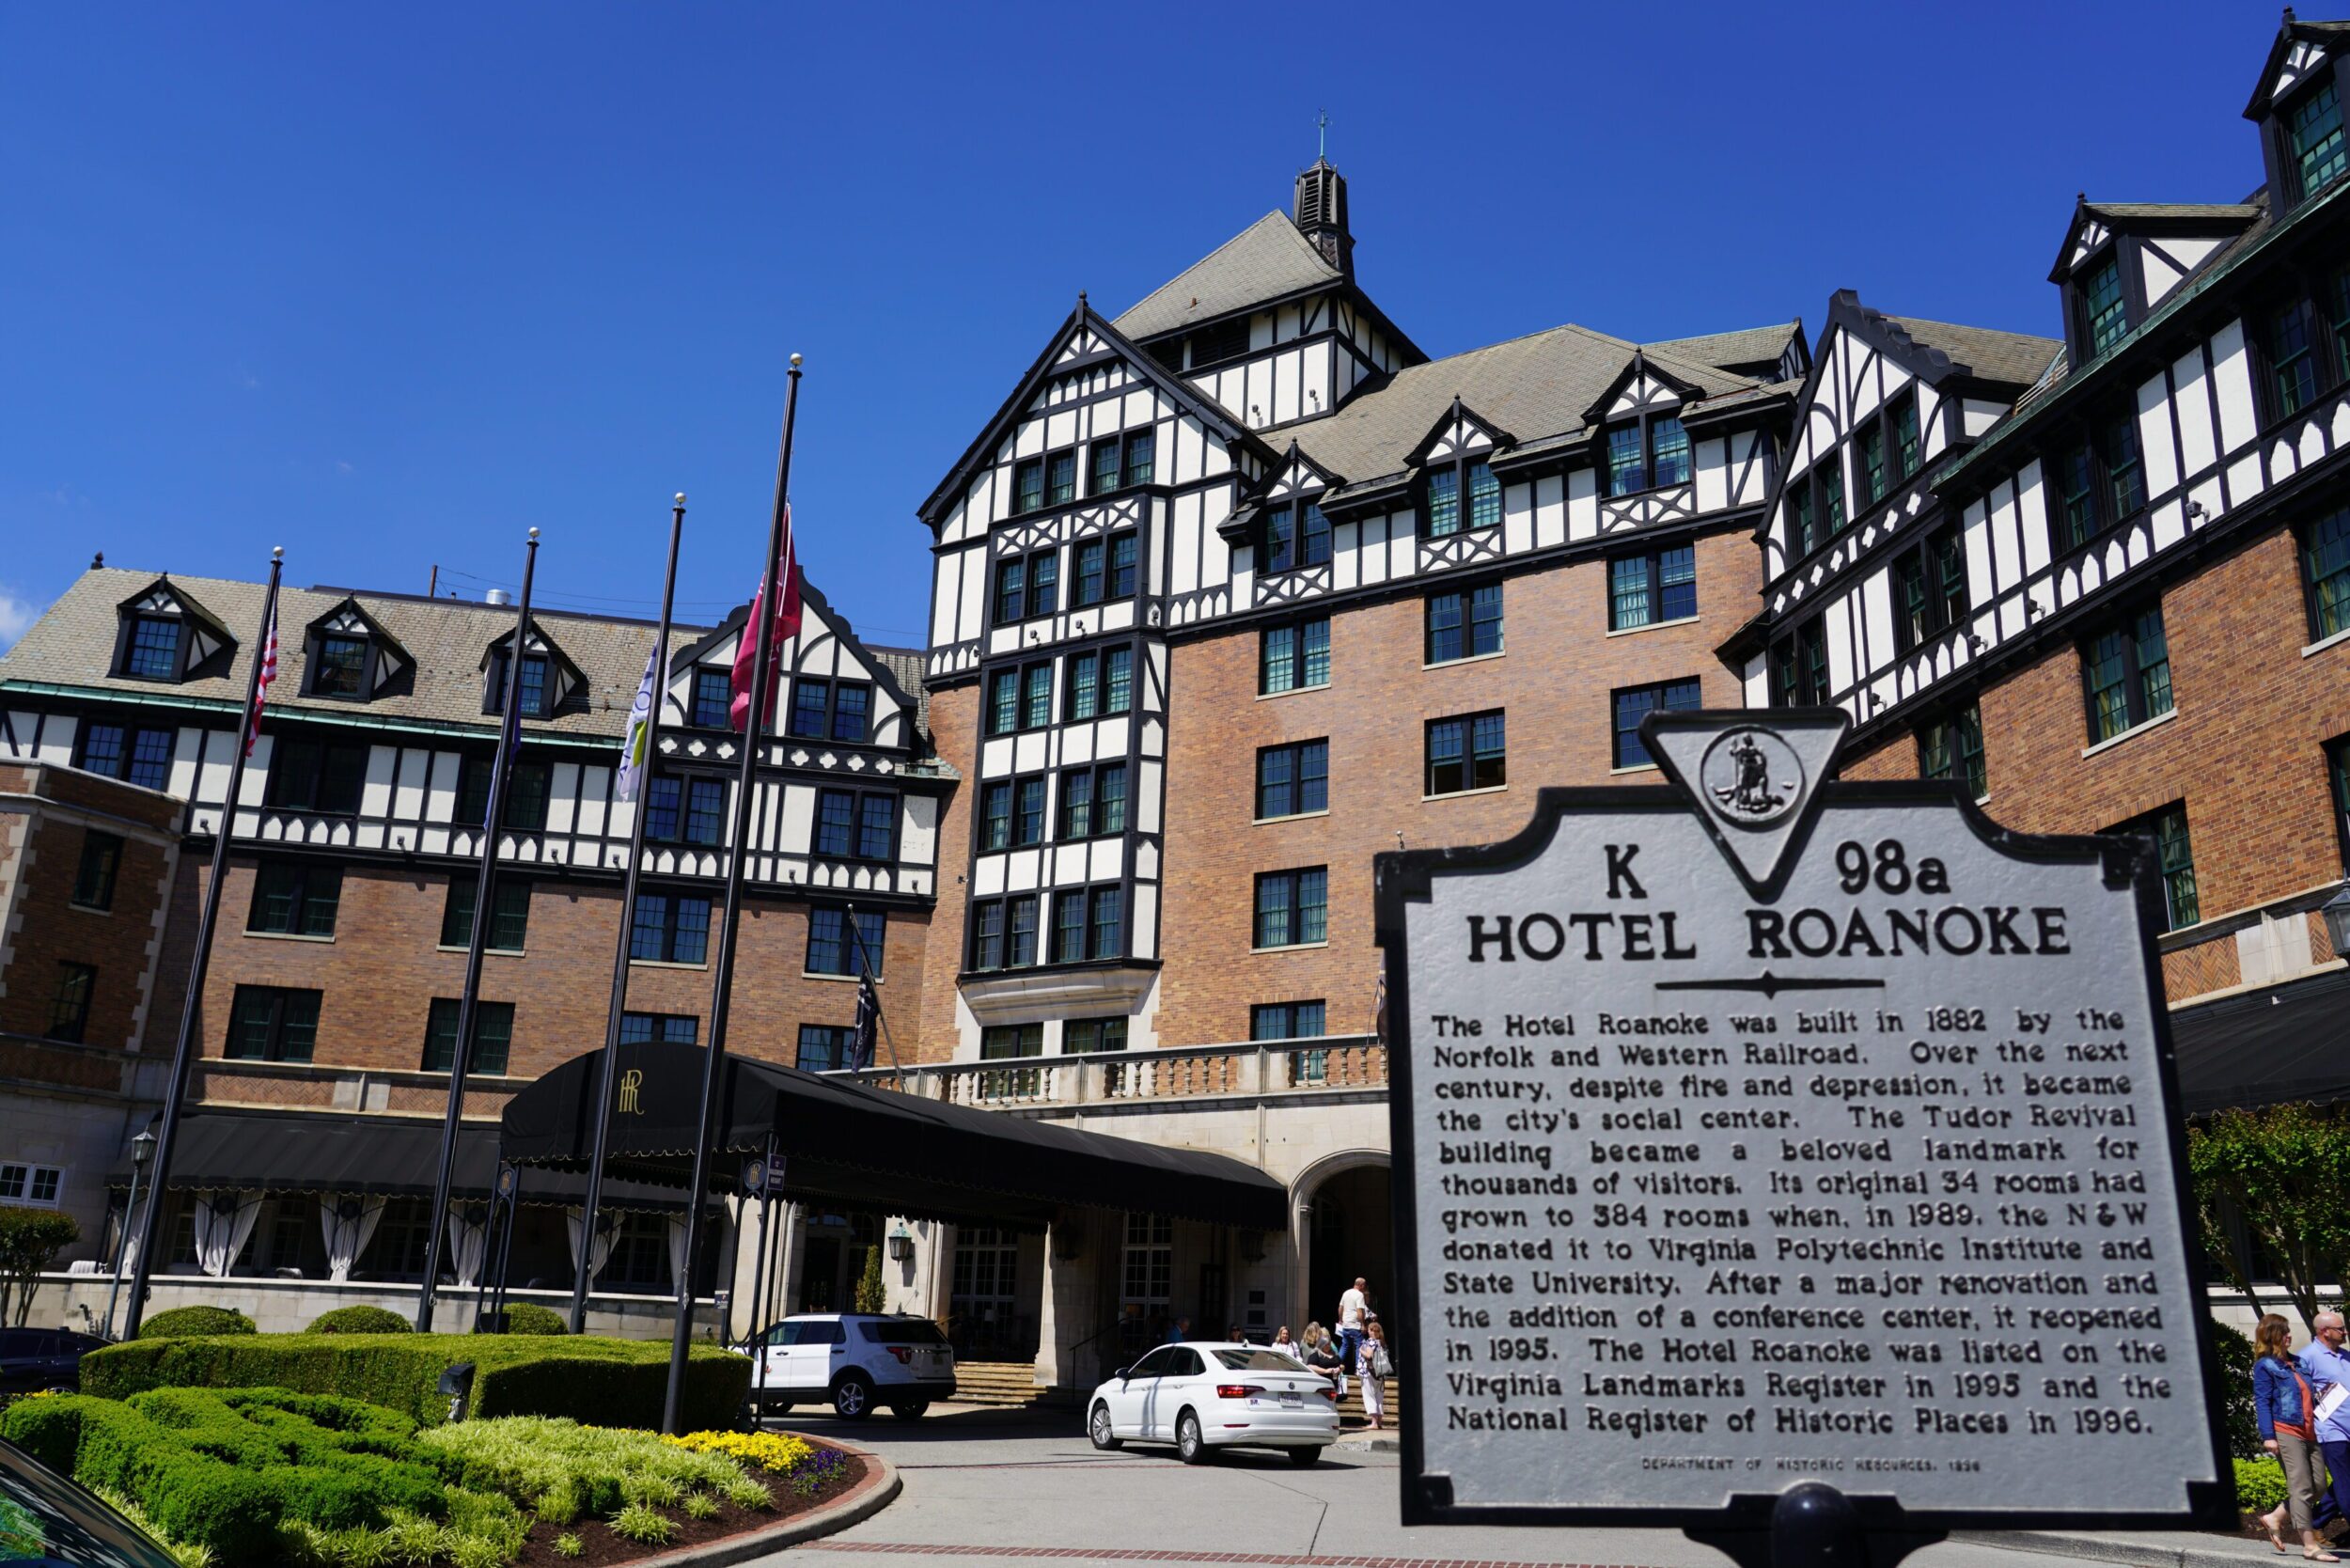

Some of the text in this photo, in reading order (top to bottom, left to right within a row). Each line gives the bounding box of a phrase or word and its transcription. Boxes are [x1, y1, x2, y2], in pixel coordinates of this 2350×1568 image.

[1605, 839, 1950, 899] K 98a
[1466, 905, 2070, 962] HOTEL ROANOKE
[1432, 1009, 2124, 1037] The Hotel Roanoke was built in 1882 by the
[1434, 1041, 2128, 1068] Norfolk and Western Railroad. Over the next
[1434, 1073, 2131, 1103] century, despite fire and depression, it became
[1437, 1105, 2136, 1134] the city's social center. The Tudor Revival
[1440, 1137, 2138, 1170] building became a beloved landmark for
[1441, 1171, 2146, 1200] thousands of visitors. Its original 34 rooms had
[1442, 1211, 1528, 1234] grown
[1545, 1207, 1574, 1227] to
[1594, 1203, 1647, 1228] 384
[1664, 1209, 1749, 1228] rooms
[1768, 1205, 1849, 1228] when,
[1867, 1206, 1893, 1228] in
[1998, 1204, 2047, 1227] the
[2067, 1203, 2086, 1225] N
[2097, 1203, 2116, 1227] &
[2122, 1202, 2147, 1225] W
[1443, 1237, 2154, 1267] donated it to Virginia Polytechnic Institute and
[1444, 1271, 2158, 1298] State University. After a major renovation and
[1445, 1305, 2163, 1334] the addition of a conference center, it reopened
[1447, 1338, 2167, 1363] in 1995. The Hotel Roanoke was listed on the
[1447, 1372, 2170, 1403] Virginia Landmarks Register in 1995 and the
[1449, 1406, 2152, 1439] National Register of Historic Places in 1996.
[1641, 1457, 1734, 1470] DEPARTMENT
[1746, 1457, 1762, 1471] OF
[1776, 1457, 1844, 1471] HISTORIC
